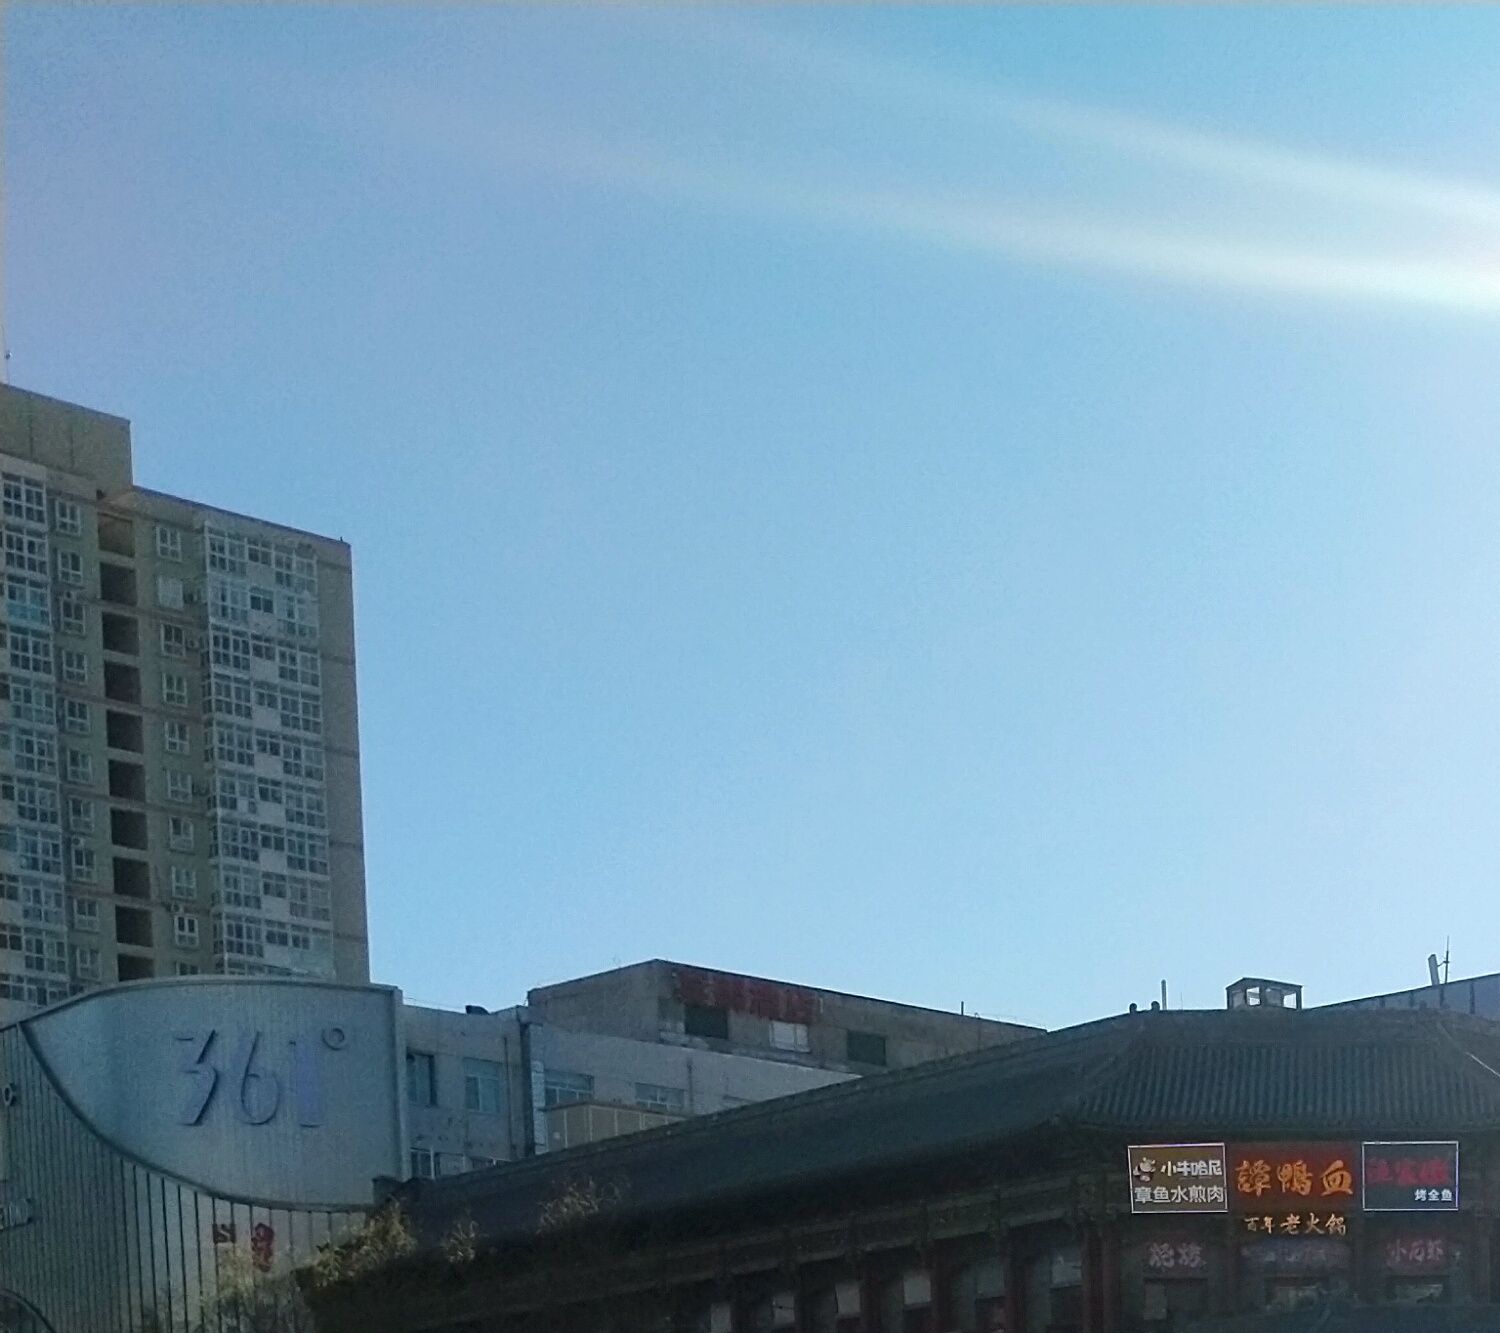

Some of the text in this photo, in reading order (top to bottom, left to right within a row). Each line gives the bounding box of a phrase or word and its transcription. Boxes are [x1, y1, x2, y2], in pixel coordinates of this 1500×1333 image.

[1160, 1158, 1223, 1178] 小牛哈尼
[1134, 1185, 1226, 1204] 章鱼水煎肉
[1414, 1188, 1453, 1202] 烤全鱼
